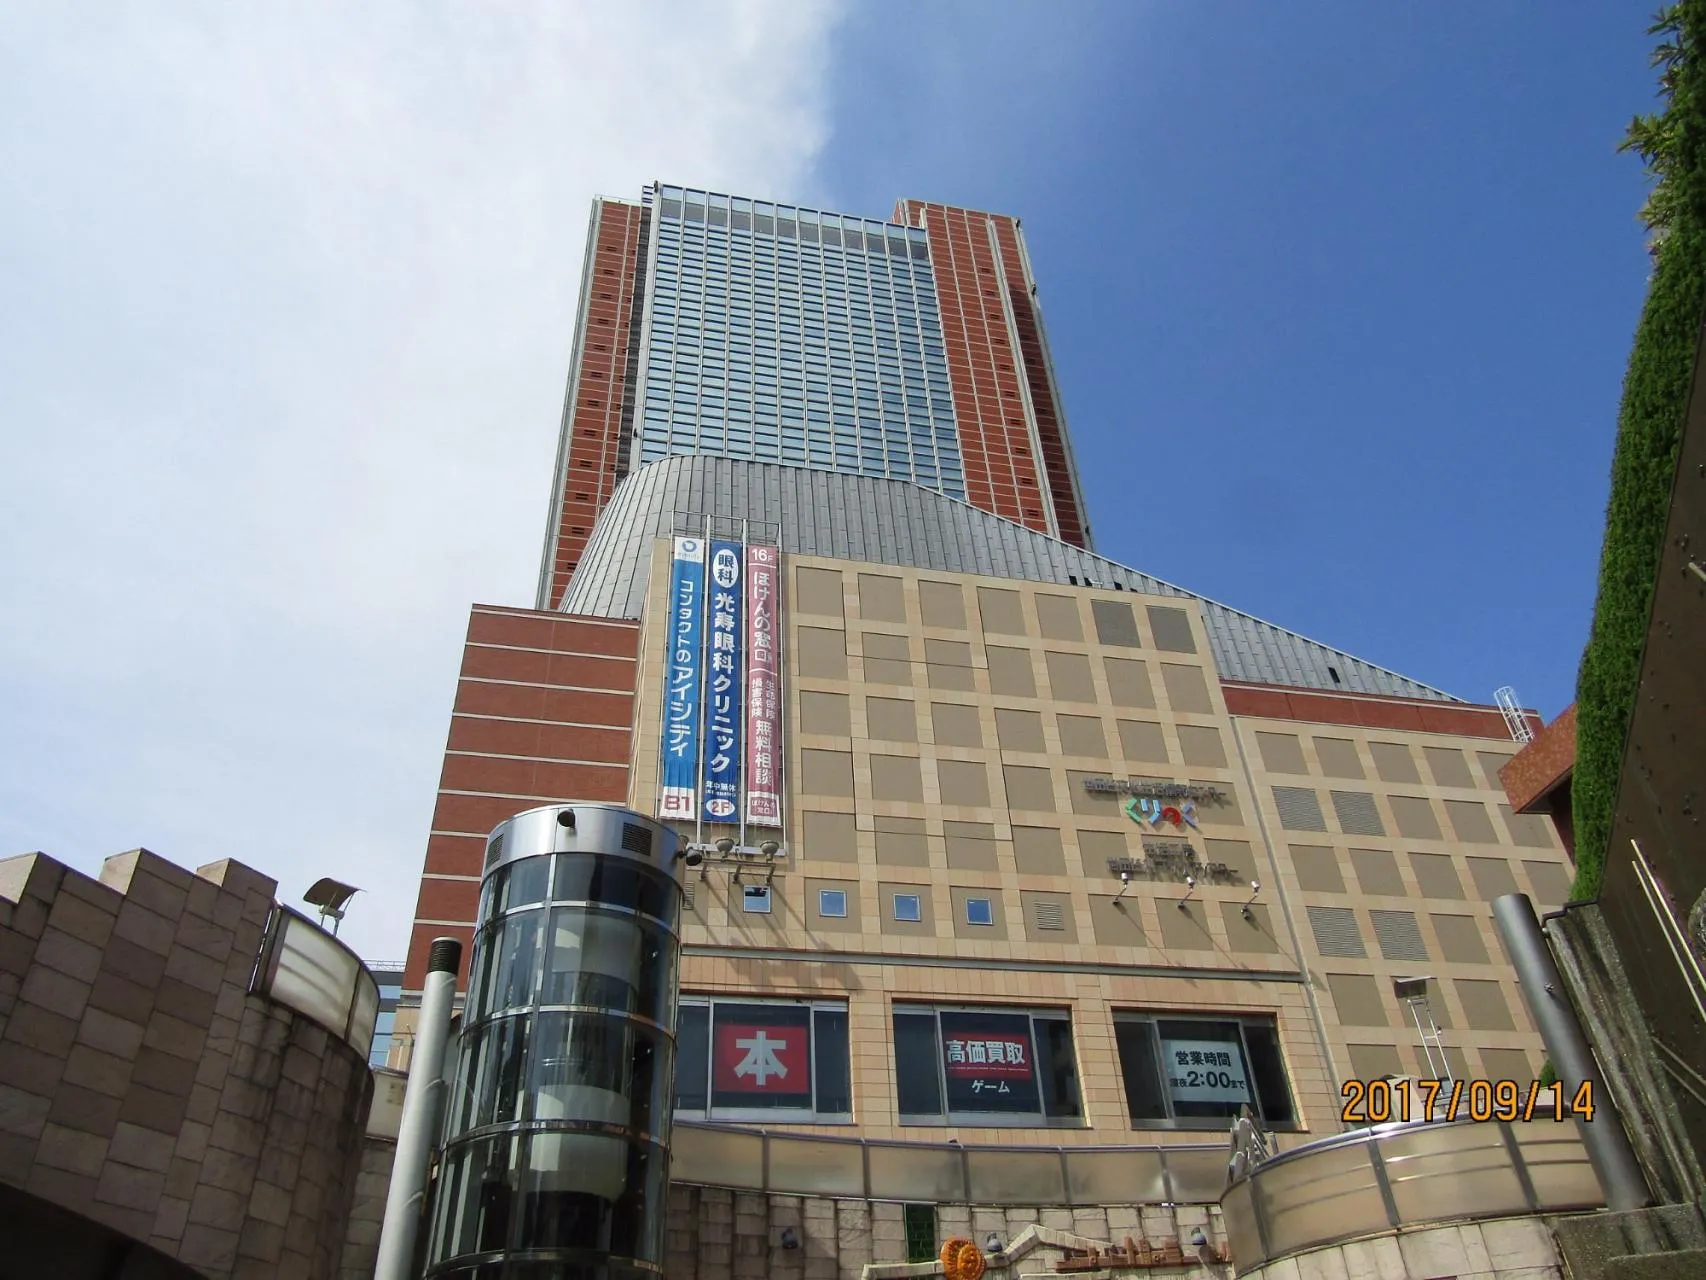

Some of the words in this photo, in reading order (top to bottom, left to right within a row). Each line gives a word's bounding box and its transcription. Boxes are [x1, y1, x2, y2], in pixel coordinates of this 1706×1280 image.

[717, 554, 734, 583] 眼科
[752, 549, 773, 562] 16F
[754, 572, 770, 661] ほけんの窓口
[669, 580, 694, 757] コンタクトのアイシティ
[711, 592, 735, 773] 光寿眼科クリニック
[755, 720, 772, 785] 無料相談
[664, 796, 689, 811] B1
[712, 801, 731, 813] 2F
[734, 1031, 788, 1085] 本
[946, 1040, 1026, 1065] 高価買取
[1175, 1050, 1231, 1067] 営業時間
[972, 1080, 1010, 1095] ゲーム
